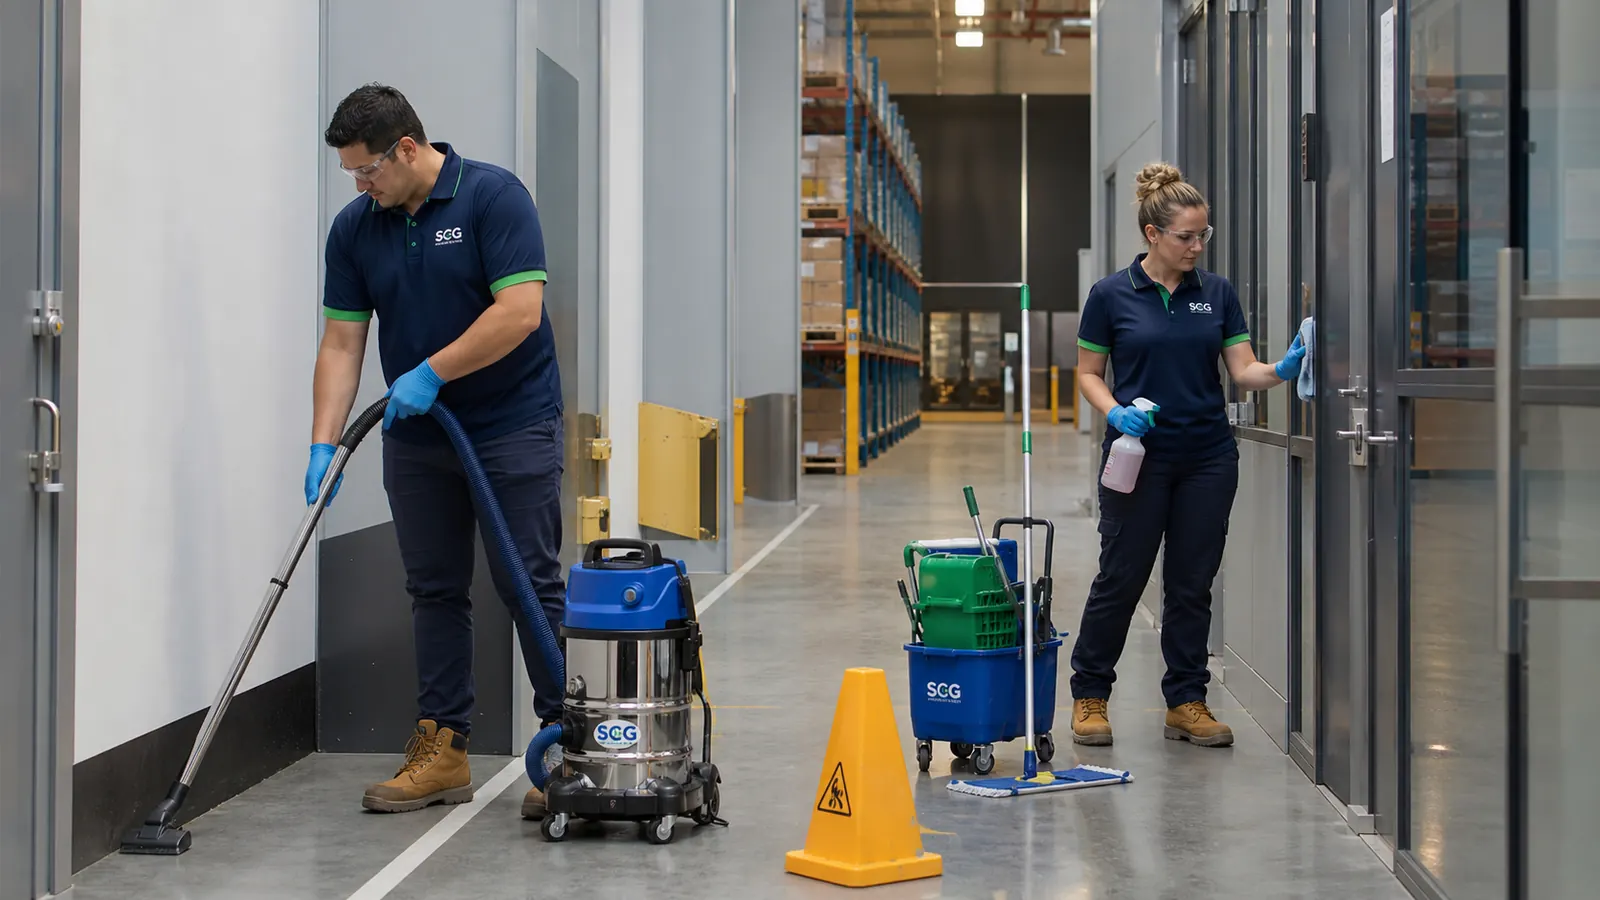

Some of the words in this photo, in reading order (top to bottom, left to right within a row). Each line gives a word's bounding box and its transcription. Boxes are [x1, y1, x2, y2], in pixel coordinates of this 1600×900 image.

[435, 227, 462, 242] SCG
[1189, 302, 1212, 311] SCG
[927, 681, 961, 699] SCG
[597, 725, 637, 741] SCG
